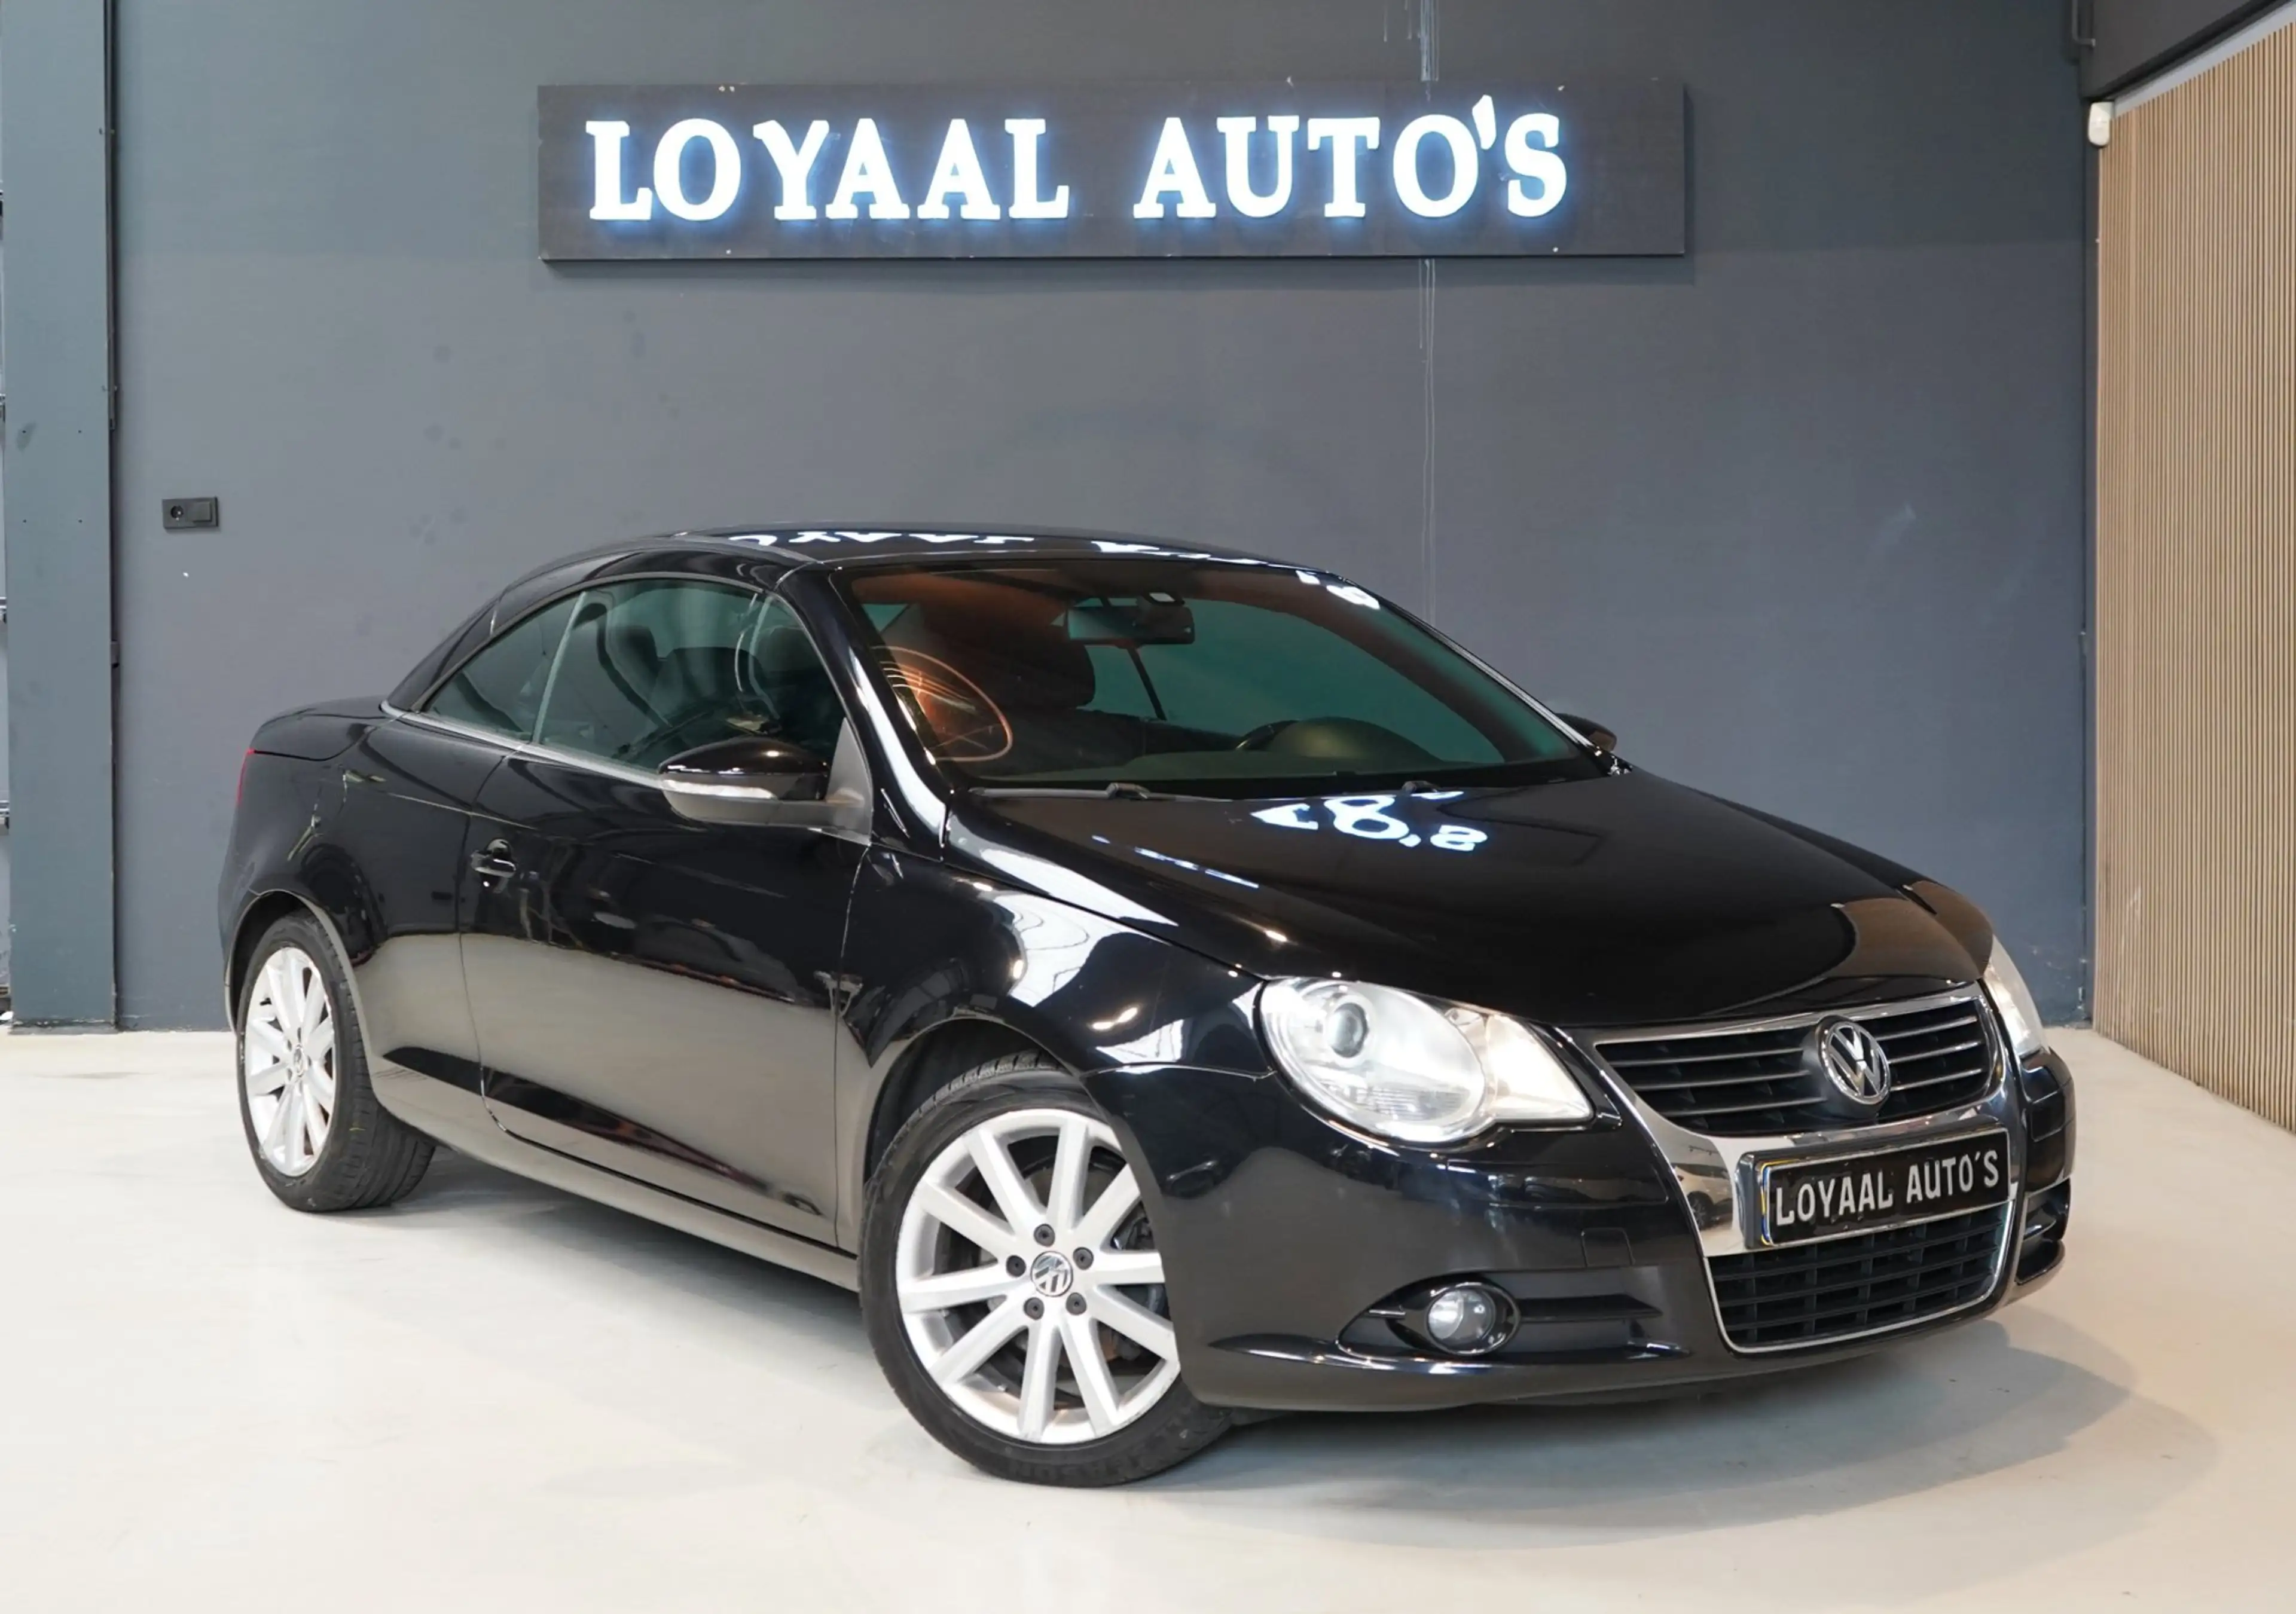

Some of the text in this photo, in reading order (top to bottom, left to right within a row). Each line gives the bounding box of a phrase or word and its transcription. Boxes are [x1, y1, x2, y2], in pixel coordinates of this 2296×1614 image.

[585, 94, 1567, 221] LOYAAL AUTO'S
[1825, 1022, 1889, 1103] VW
[1776, 1171, 1894, 1227] LOYAAL
